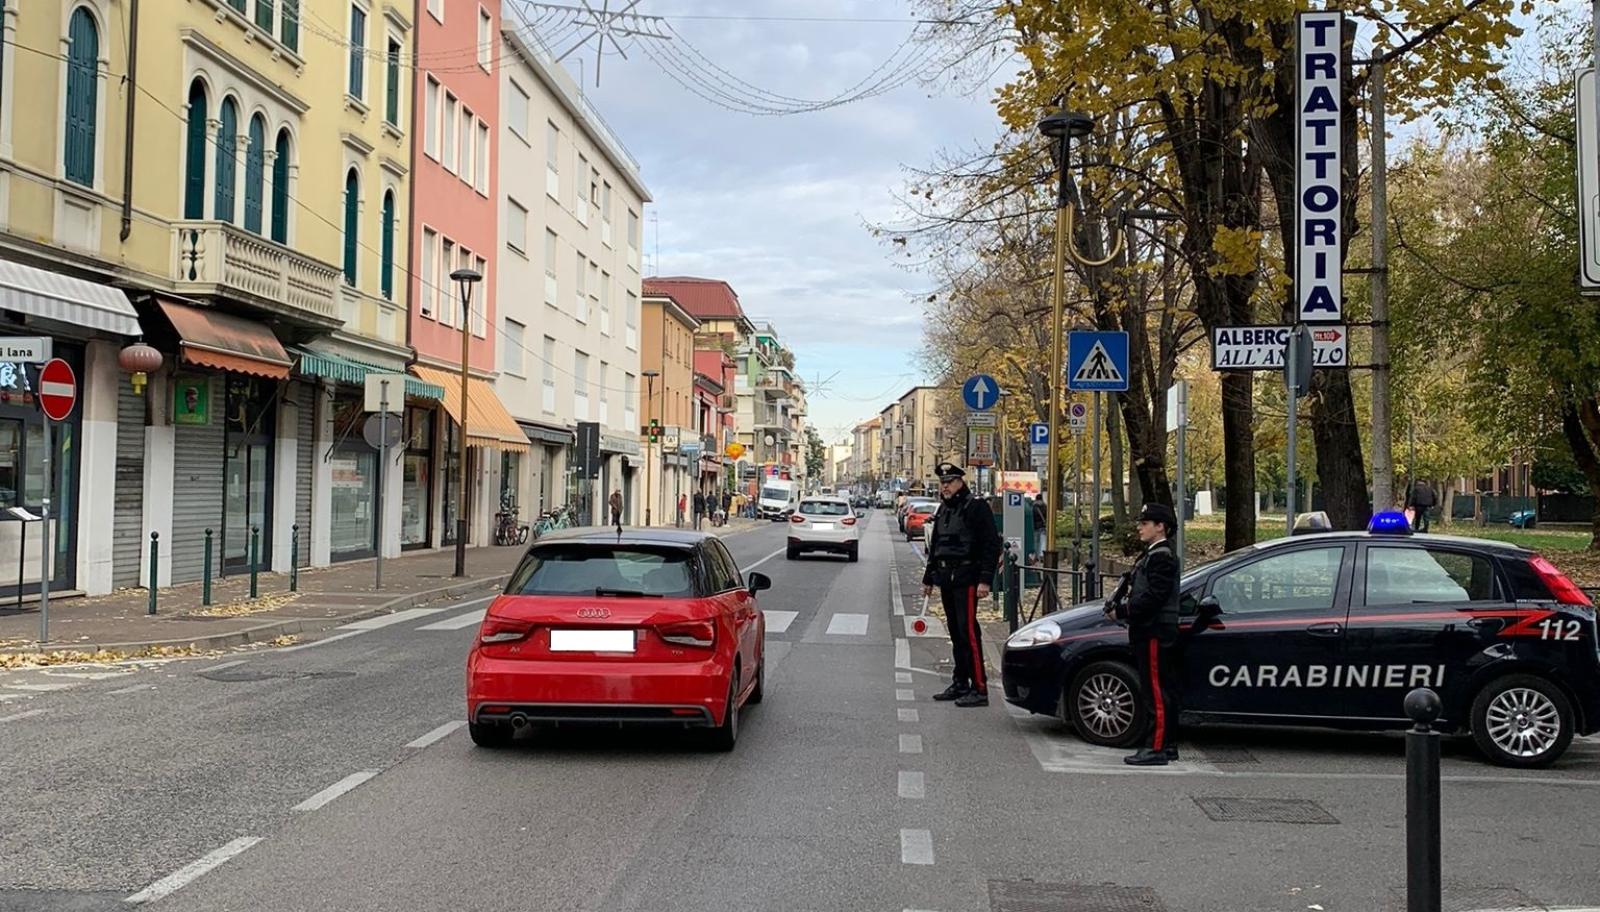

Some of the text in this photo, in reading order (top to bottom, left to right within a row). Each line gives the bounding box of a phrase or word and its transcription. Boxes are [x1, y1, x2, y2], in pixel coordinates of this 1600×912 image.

[1302, 19, 1339, 313] TRATTORIA
[1217, 329, 1290, 346] ALBERG
[8, 347, 32, 357] lana
[1035, 425, 1049, 442] P
[1010, 494, 1020, 507] P
[1539, 618, 1581, 641] 112
[1208, 664, 1446, 688] CARABINIERI
